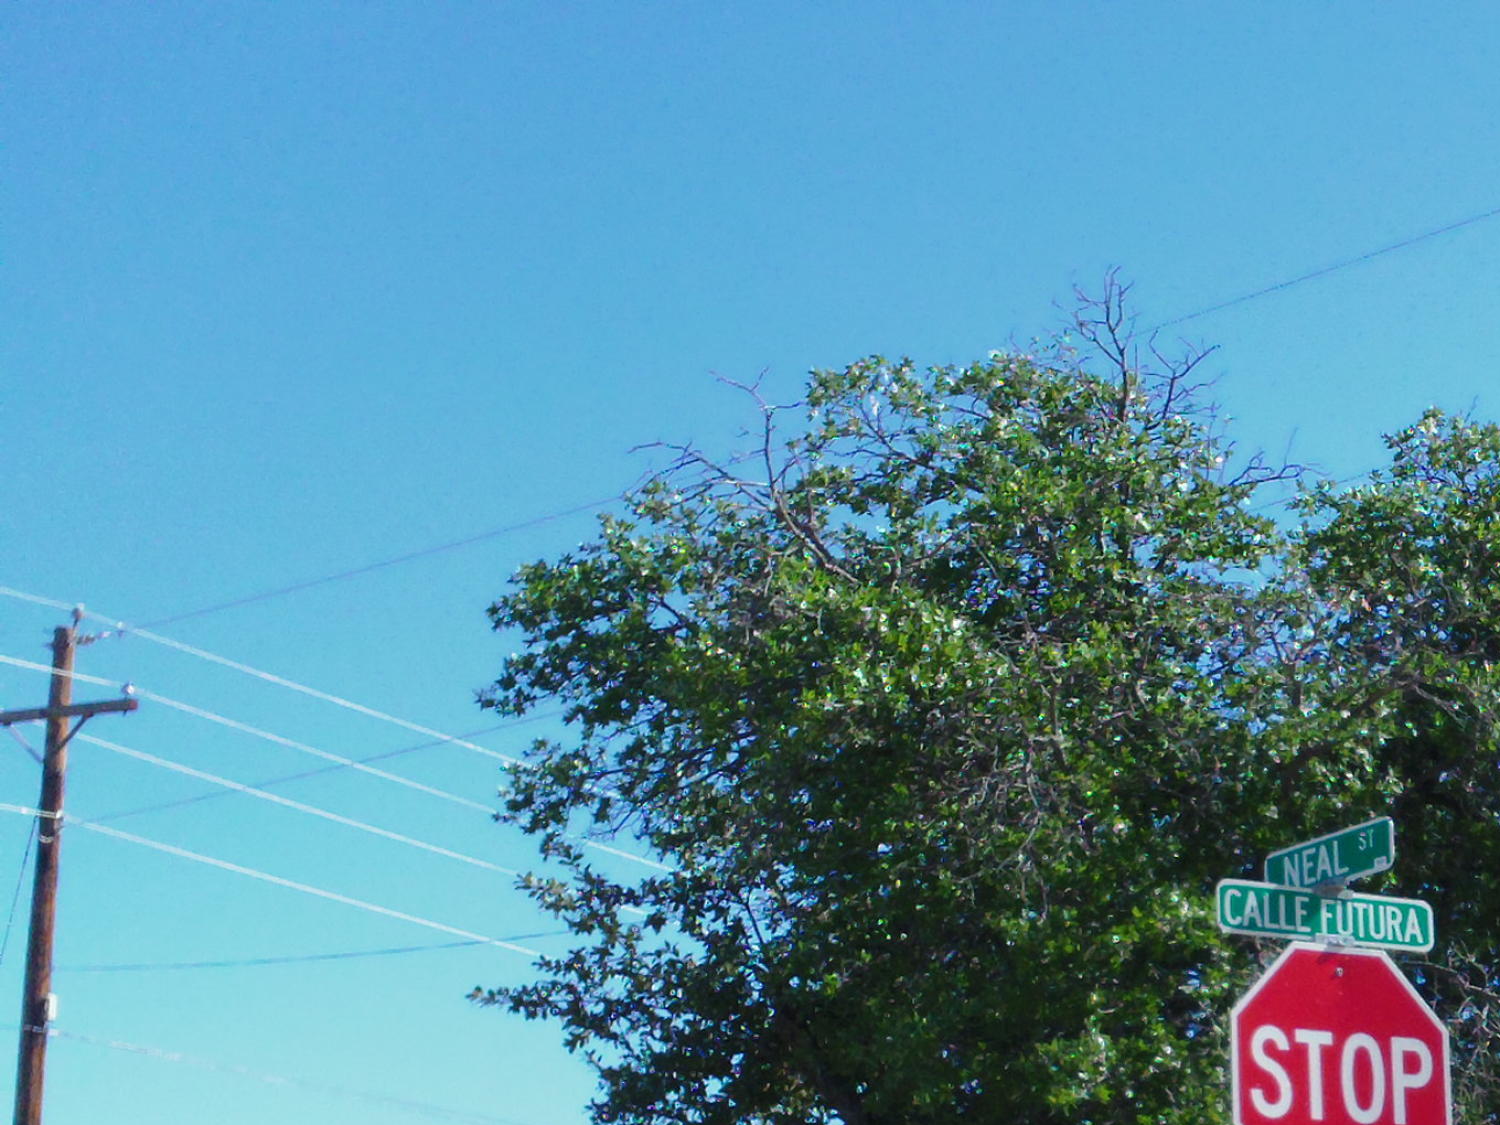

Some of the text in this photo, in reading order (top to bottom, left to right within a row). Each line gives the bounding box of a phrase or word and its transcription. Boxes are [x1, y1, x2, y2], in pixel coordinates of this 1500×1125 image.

[1283, 829, 1374, 887] NEAL ST
[1224, 889, 1424, 943] CALLE FUTURA
[1250, 1024, 1433, 1125] STOP
